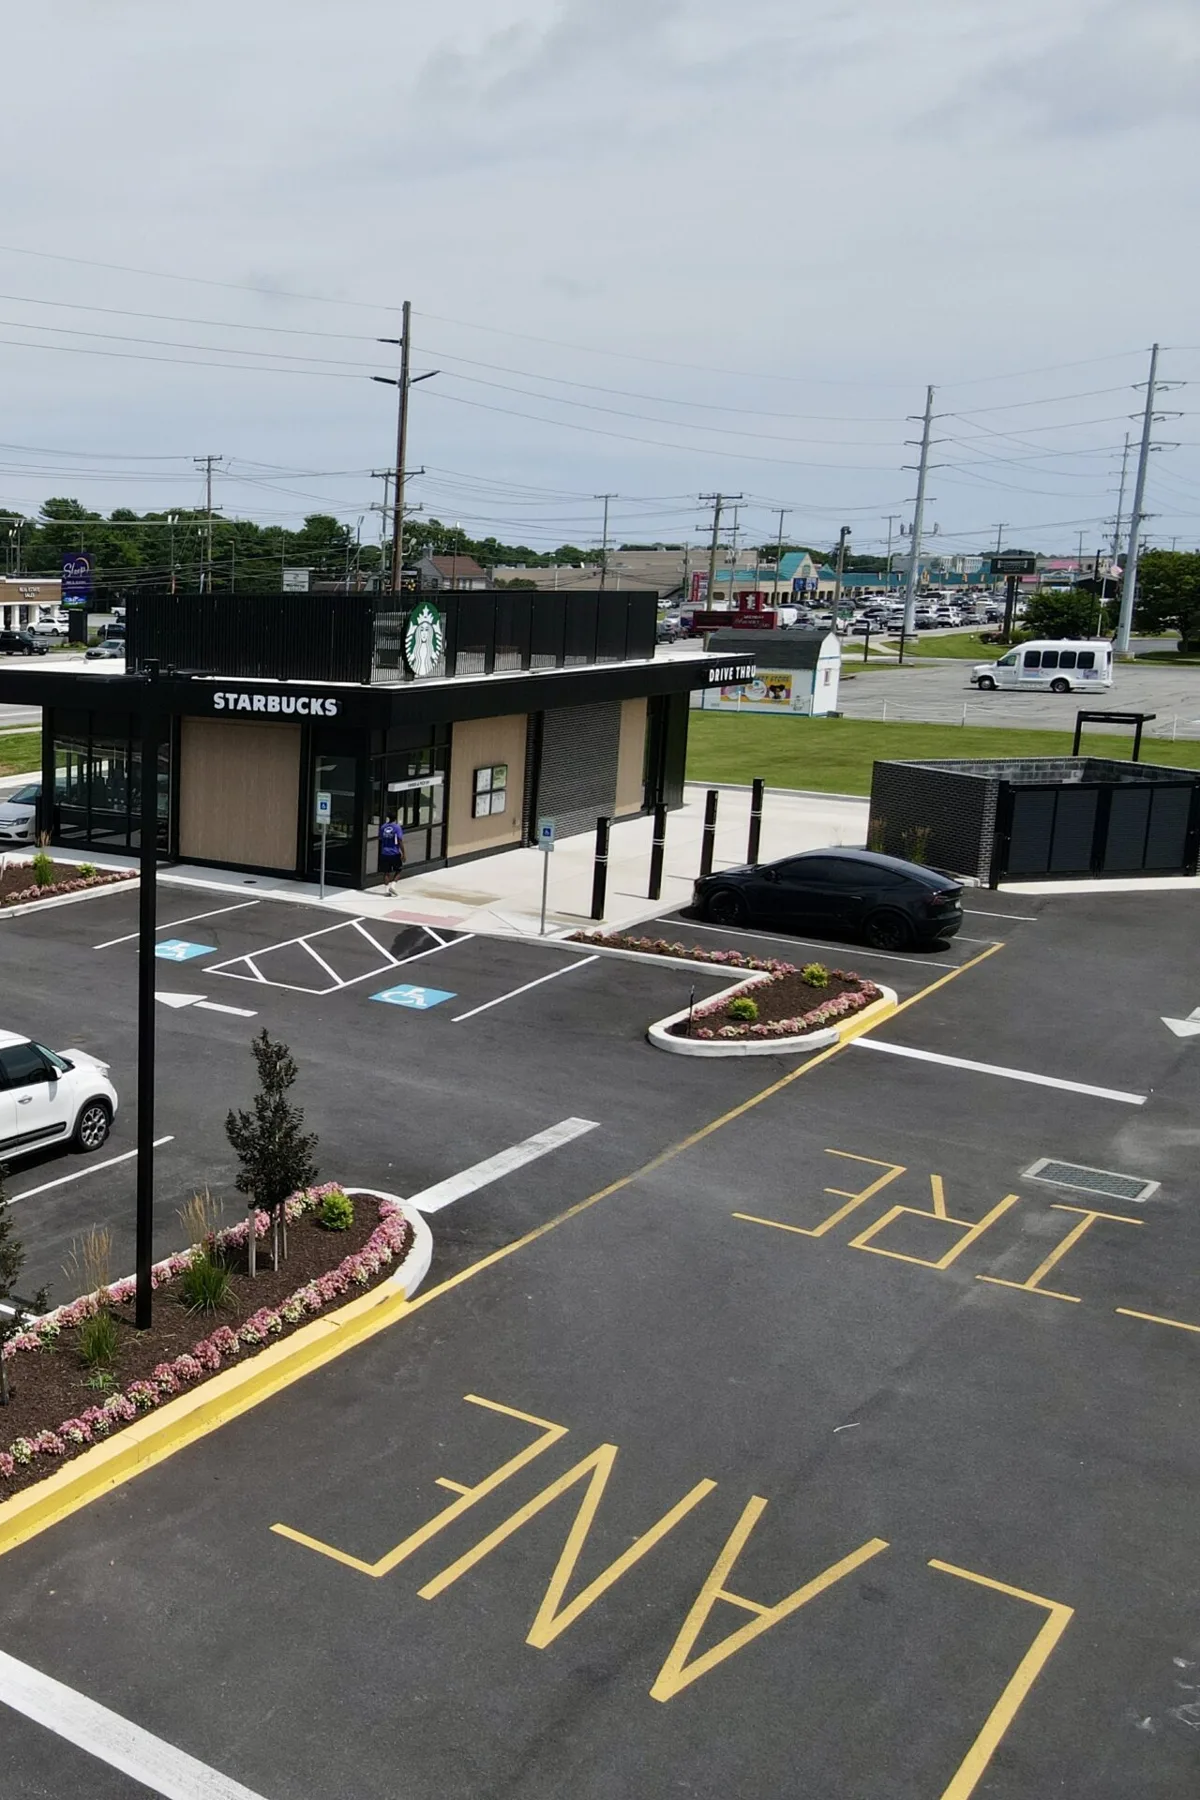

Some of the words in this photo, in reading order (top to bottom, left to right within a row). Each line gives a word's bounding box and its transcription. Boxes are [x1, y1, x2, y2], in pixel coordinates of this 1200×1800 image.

[708, 668, 734, 682] DRIVE
[735, 665, 757, 679] THRU
[213, 692, 338, 717] STARBUCKS
[269, 1393, 1075, 1800] LANE
